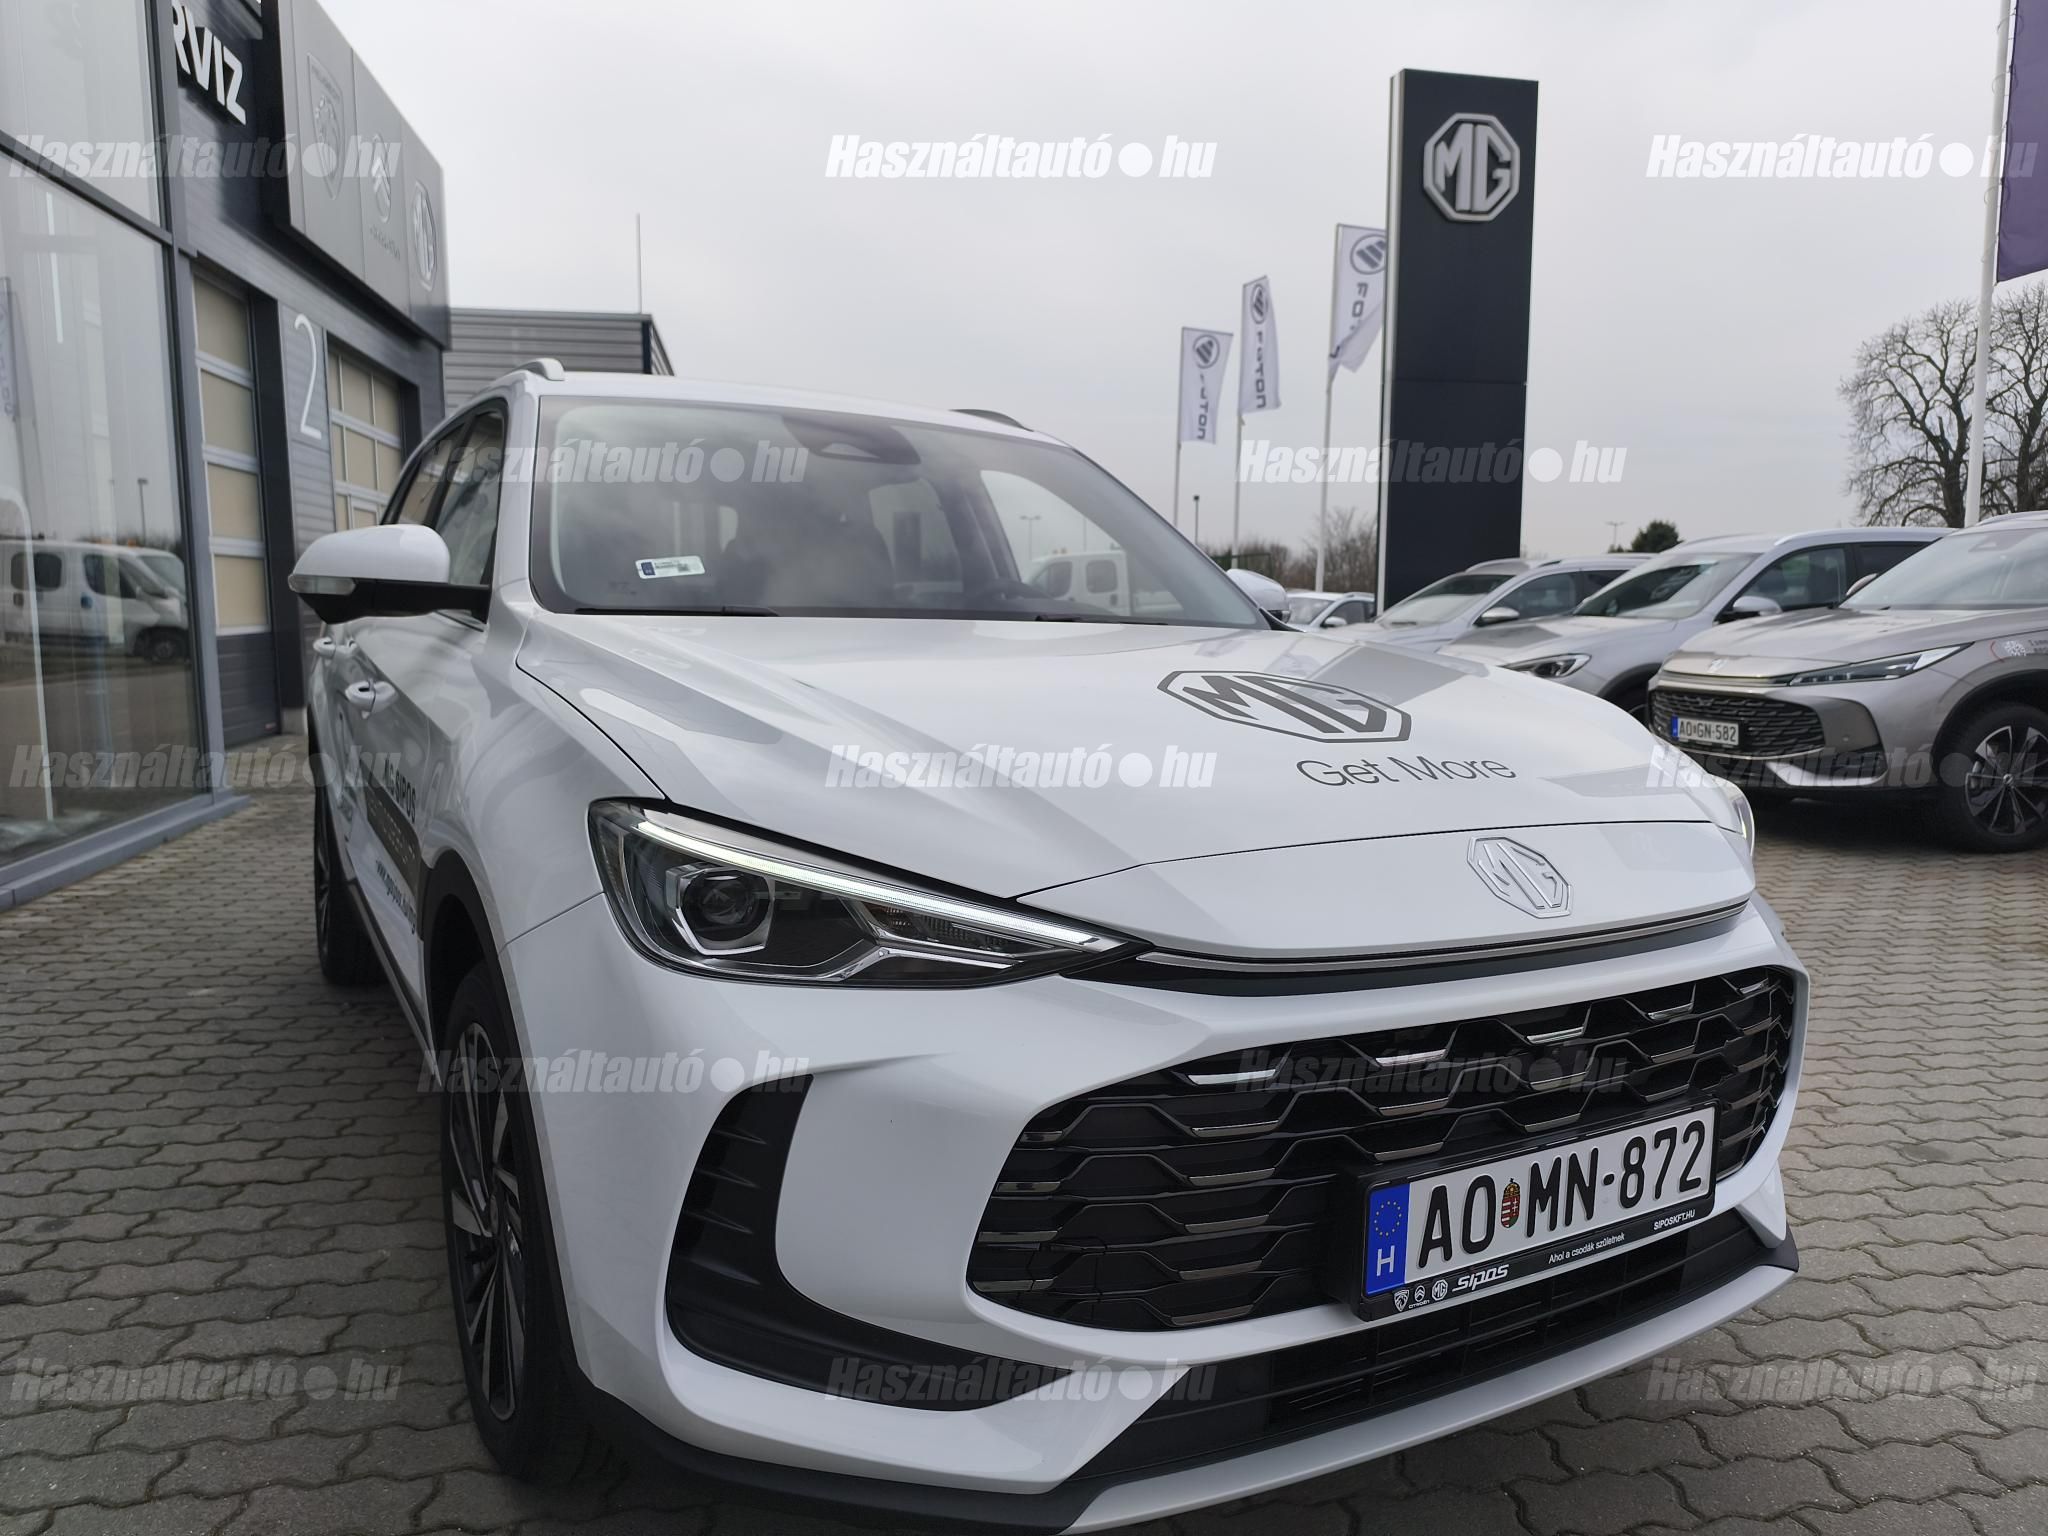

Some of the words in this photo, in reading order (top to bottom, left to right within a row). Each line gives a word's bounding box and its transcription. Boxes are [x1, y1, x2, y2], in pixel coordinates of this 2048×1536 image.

[1435, 123, 1511, 212] MG
[295, 314, 321, 439] 2
[1183, 675, 1387, 734] MG
[1680, 721, 1692, 737] AO
[1697, 722, 1736, 742] GN-582
[1297, 759, 1399, 786] Get
[1388, 755, 1516, 781] More
[1478, 842, 1564, 909] MG
[1375, 1246, 1395, 1277] H
[1418, 1174, 1496, 1269] AO
[1526, 1120, 1705, 1238] MN-872
[1653, 1209, 1696, 1230] SIPOSKFT.HU
[1548, 1249, 1564, 1264] Ahol
[1565, 1250, 1570, 1259] a
[1571, 1242, 1595, 1257] csodák
[1595, 1231, 1625, 1250] születnek
